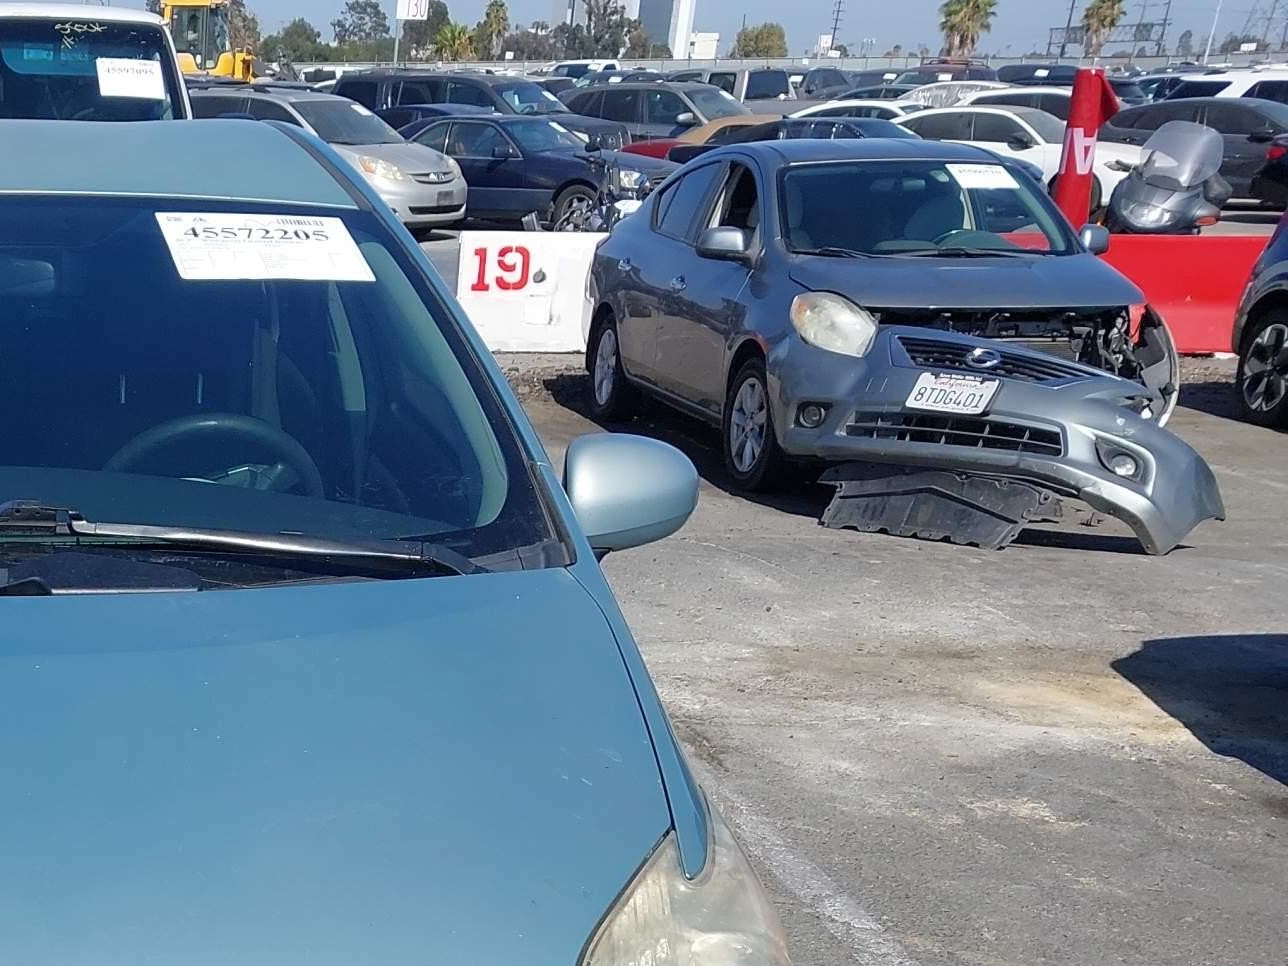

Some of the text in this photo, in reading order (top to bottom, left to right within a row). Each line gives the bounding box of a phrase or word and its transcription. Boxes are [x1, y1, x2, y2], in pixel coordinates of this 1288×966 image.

[183, 226, 329, 242] 45572205
[471, 246, 531, 292] 19
[914, 386, 984, 409] 8TDG401
